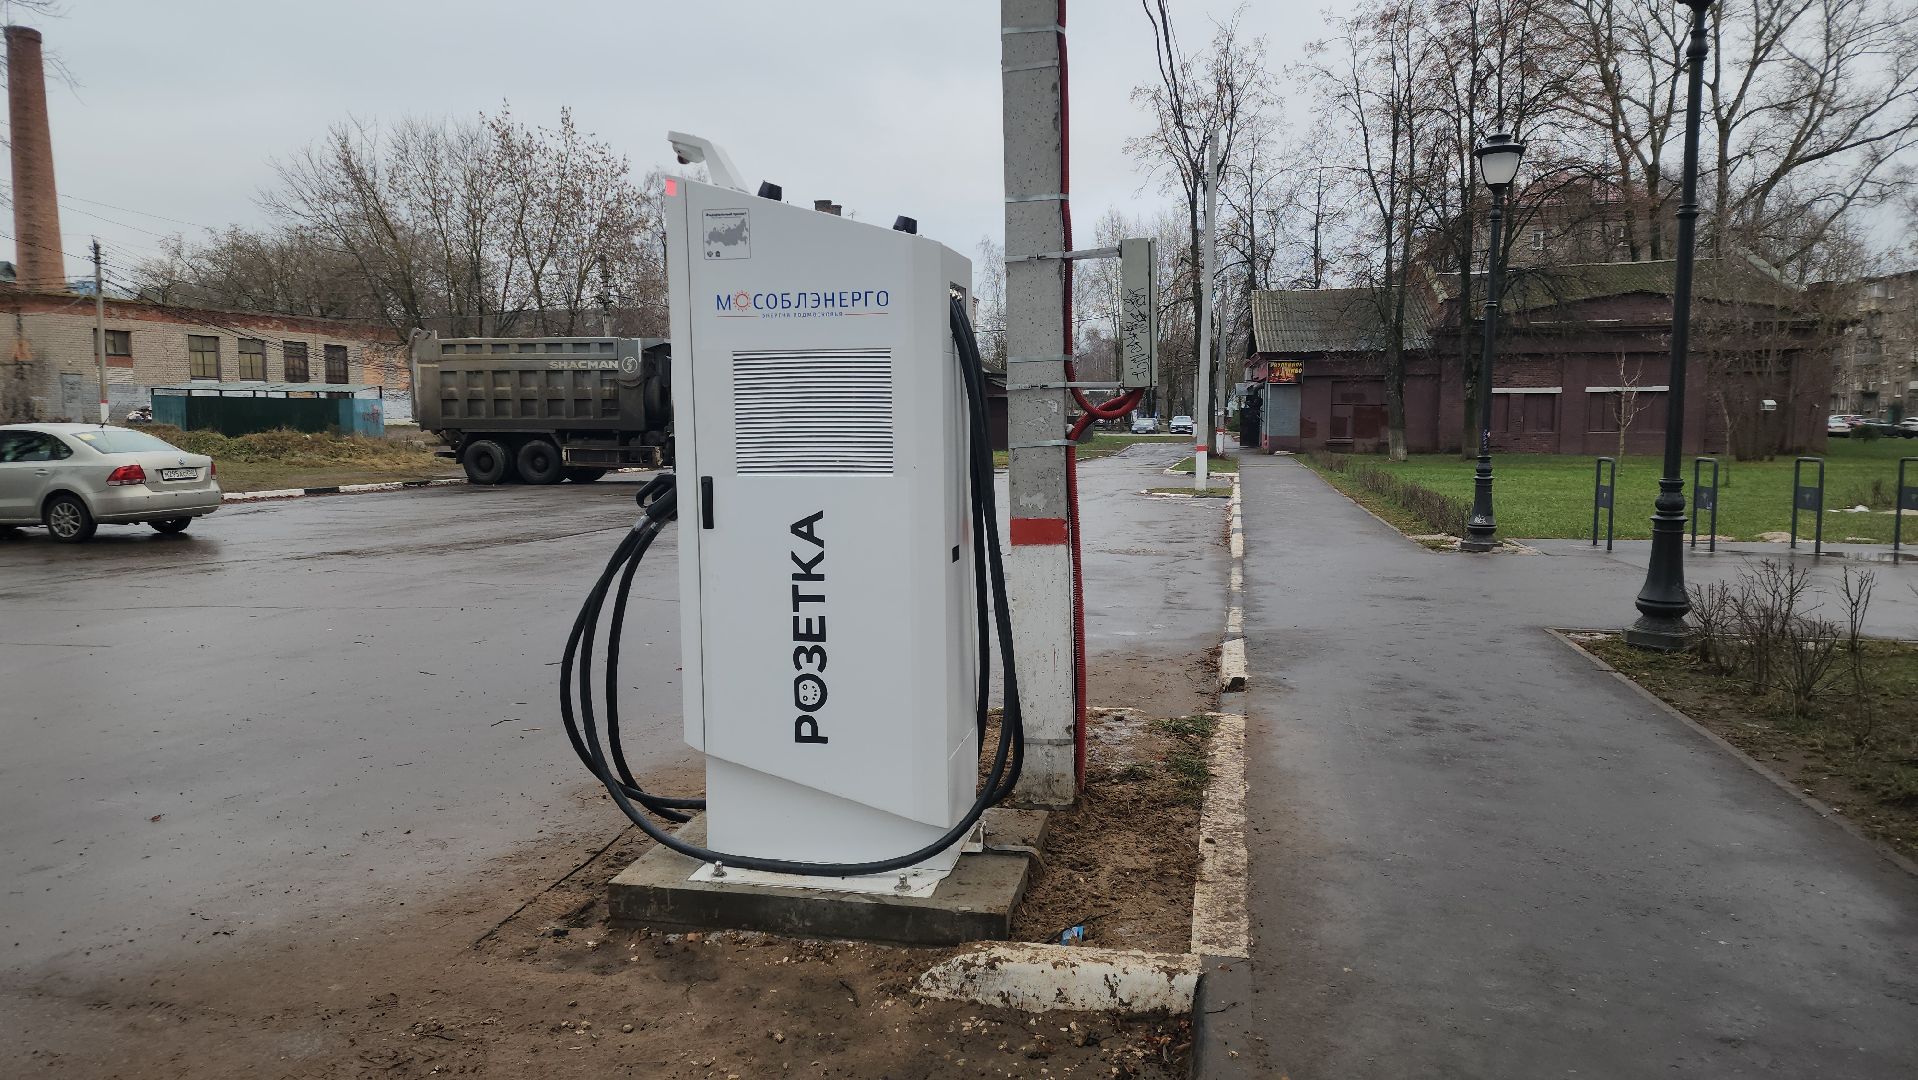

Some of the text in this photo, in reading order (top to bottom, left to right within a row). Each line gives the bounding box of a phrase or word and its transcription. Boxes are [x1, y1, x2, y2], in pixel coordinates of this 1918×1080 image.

[716, 290, 889, 312] МОСОБЛЭНЕРГО
[548, 360, 619, 369] SHACMAN
[790, 510, 829, 744] РОЗЕТКА
